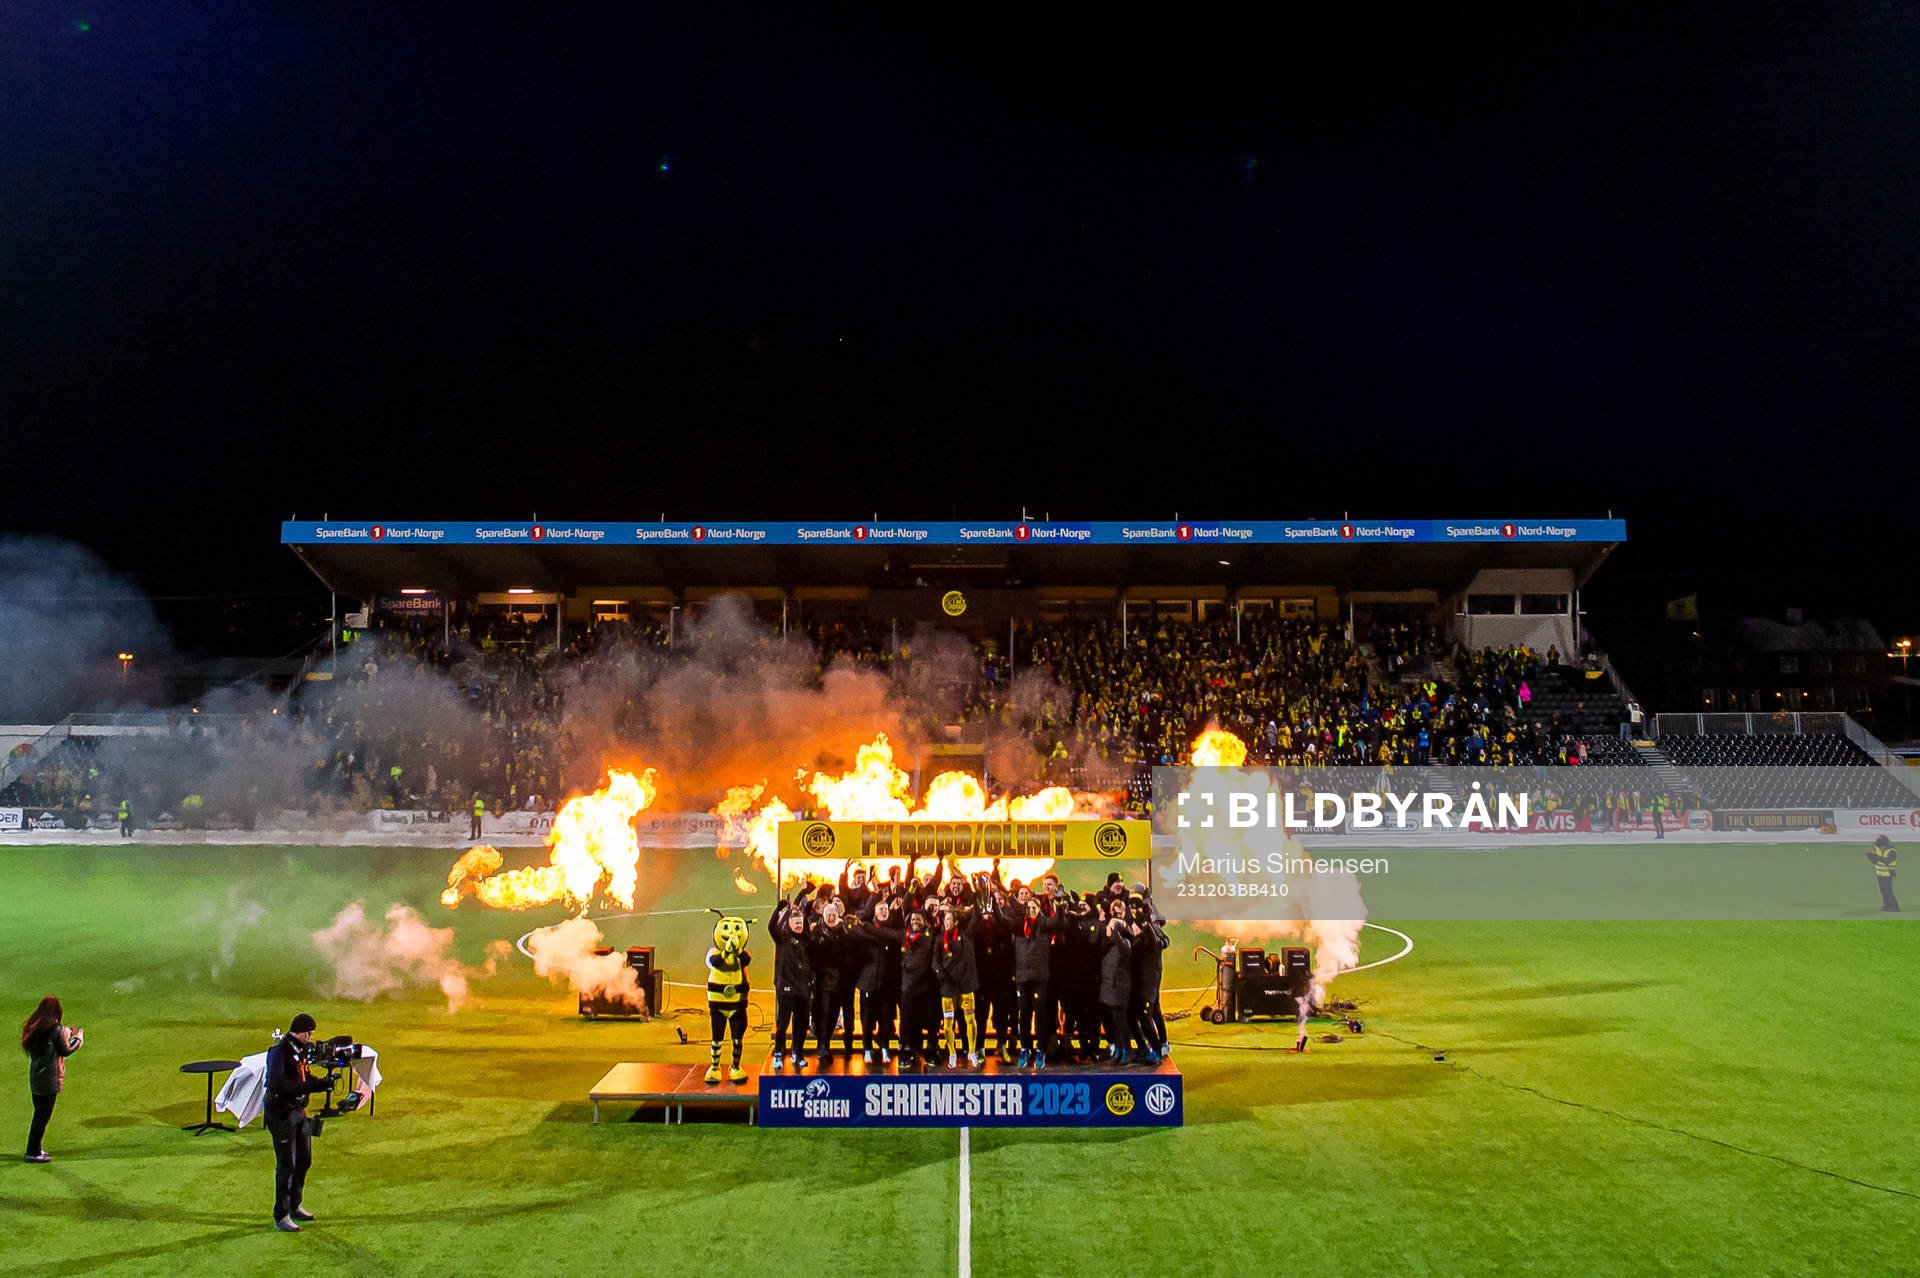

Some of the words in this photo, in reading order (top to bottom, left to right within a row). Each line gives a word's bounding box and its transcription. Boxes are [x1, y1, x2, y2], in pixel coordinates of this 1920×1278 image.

[317, 528, 367, 539] SpareBank
[387, 528, 443, 539] Nord-Norge
[476, 528, 527, 539] SpareBank
[547, 528, 604, 539] Nord-Norge
[637, 528, 688, 540] SpareBank
[708, 528, 765, 540] Nord-Norge
[798, 528, 850, 540] SpareBank
[870, 528, 927, 540] Nord-Norge
[960, 527, 1012, 540] SpareBank
[1032, 527, 1090, 540] Nord-Norge
[1123, 527, 1175, 539] SpareBank
[1194, 527, 1252, 539] Nord-Norge
[1285, 526, 1338, 539] SpareBank
[1357, 526, 1414, 539] Nord-Norge
[1447, 526, 1500, 538] SpareBank
[1519, 526, 1576, 538] Nord-Norge
[380, 598, 441, 610] SpareBank
[1535, 815, 1575, 830] AVIS
[1728, 815, 1745, 826] THE
[1859, 814, 1907, 825] CIRCLE
[861, 824, 894, 856] FK
[771, 1090, 805, 1108] ELITE
[865, 1083, 1023, 1116] SERIEMESTER
[1028, 1083, 1091, 1116] 2023
[804, 1099, 850, 1118] SERIEN
